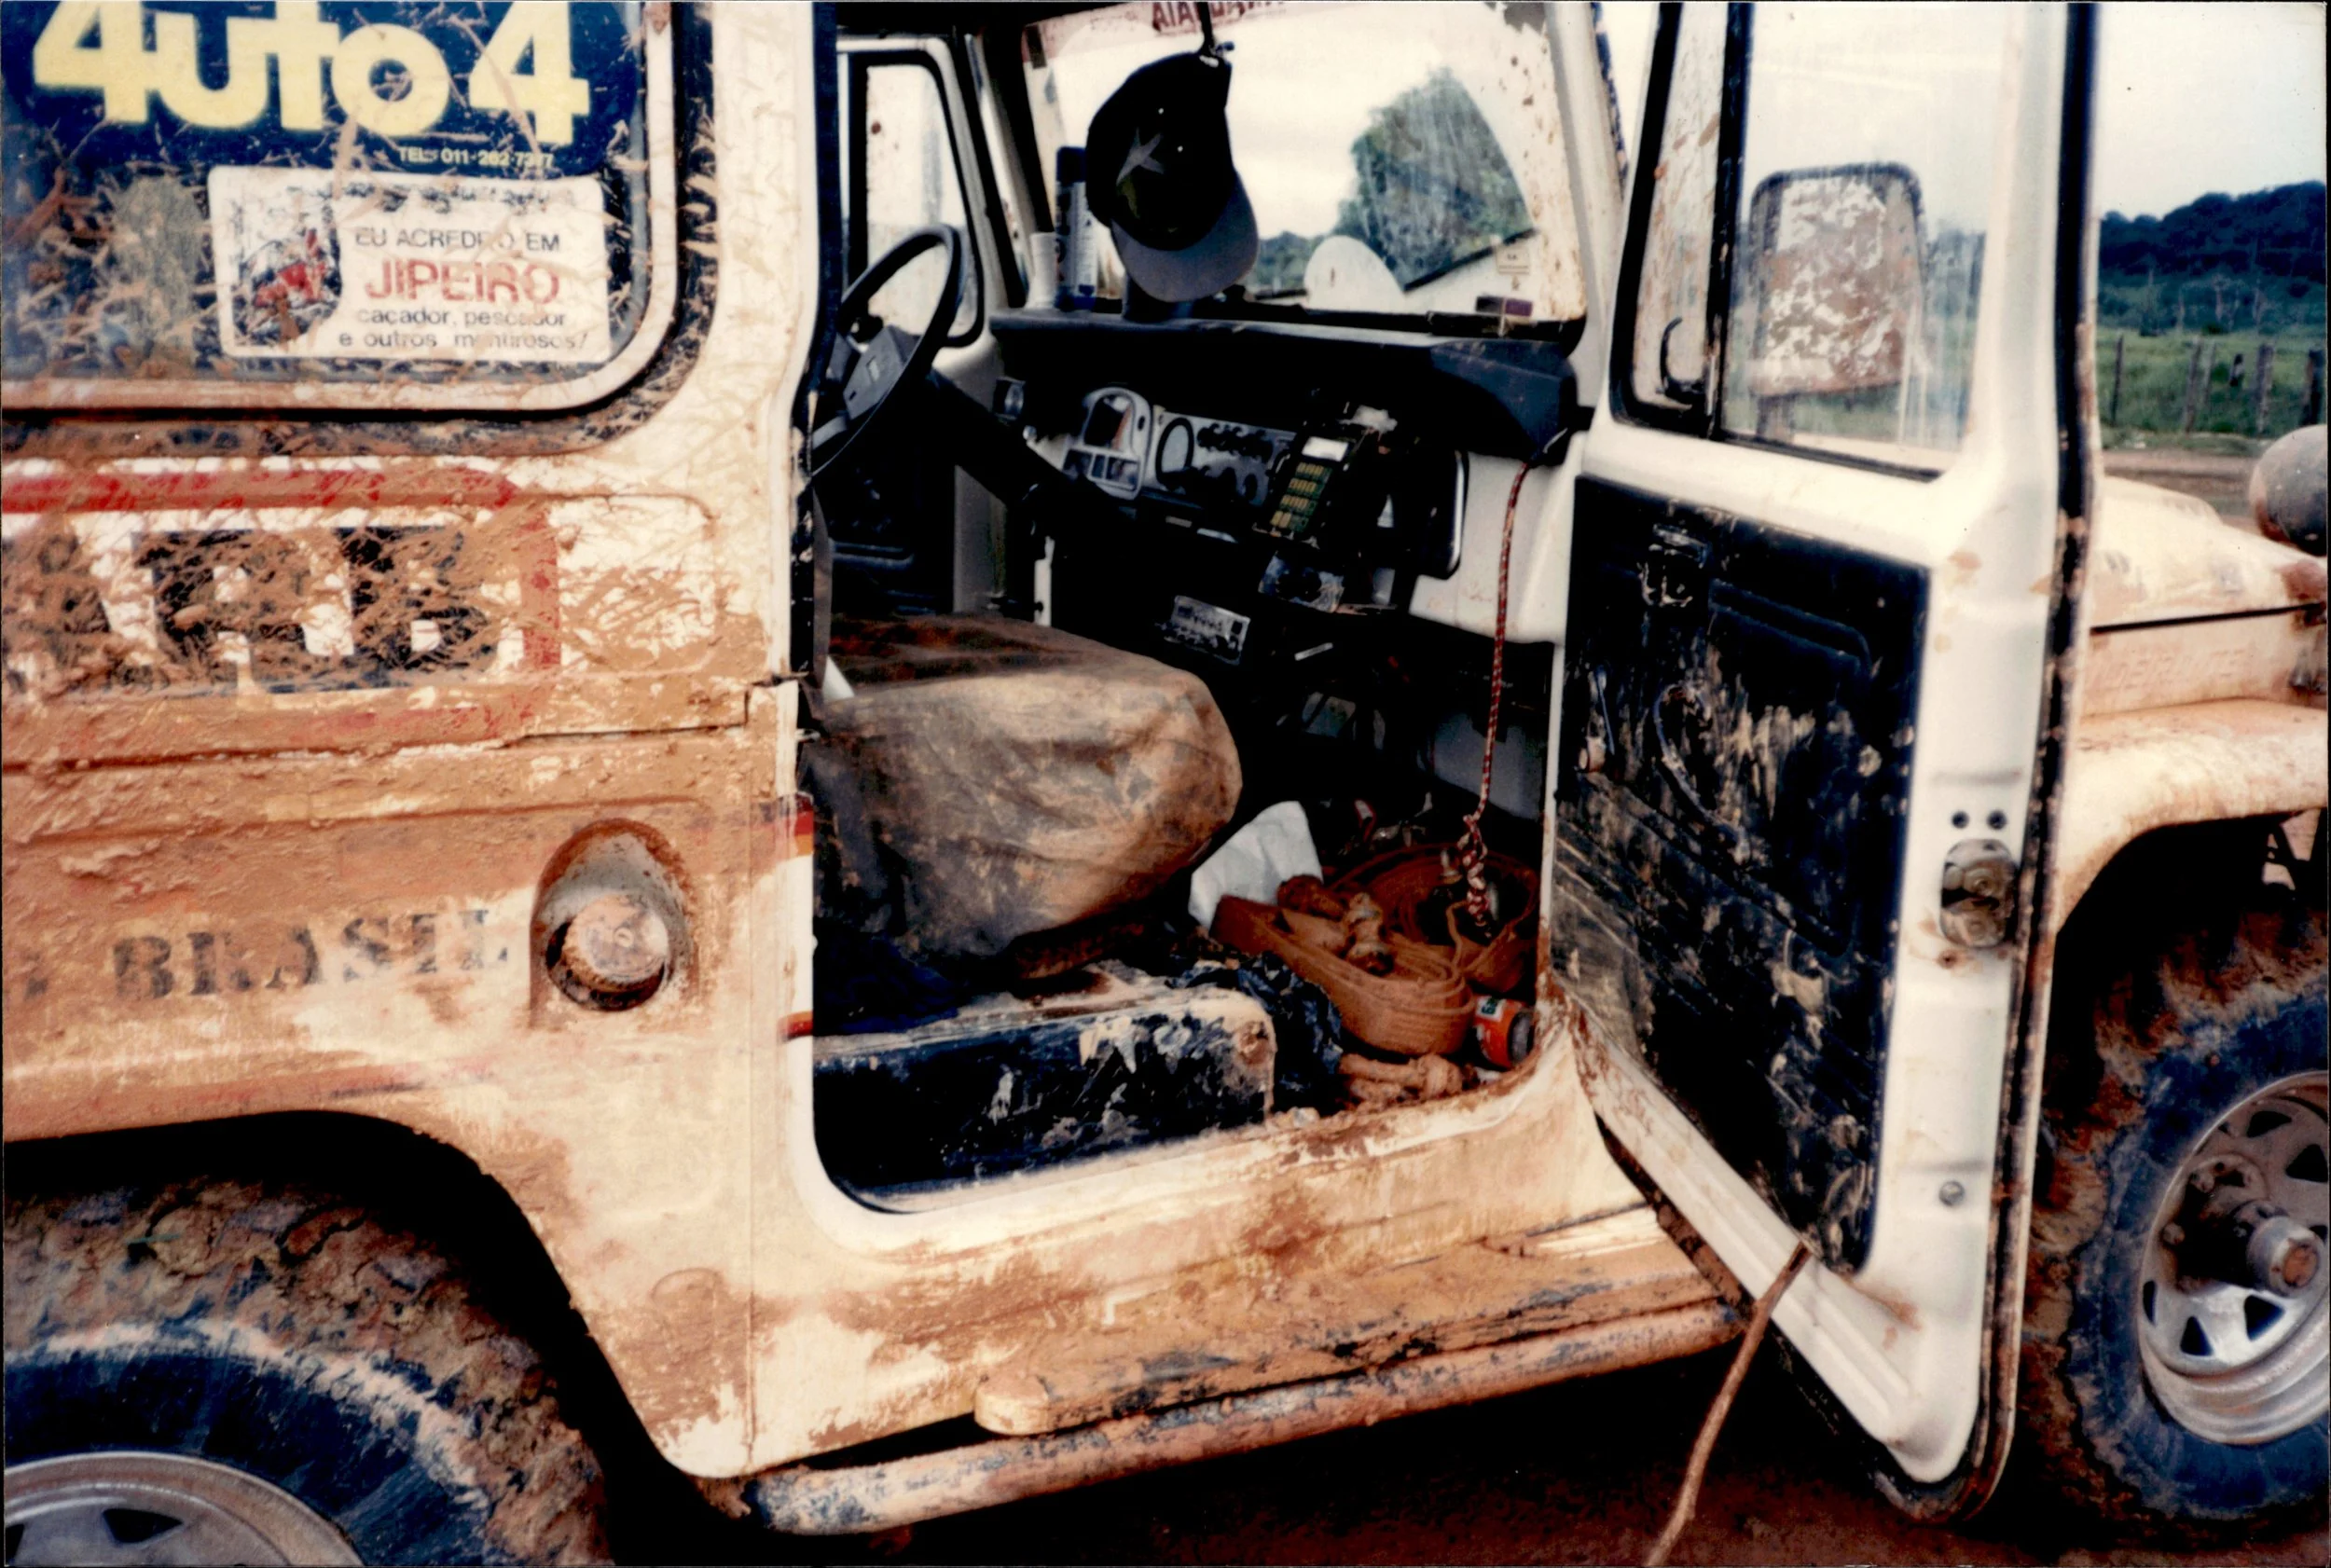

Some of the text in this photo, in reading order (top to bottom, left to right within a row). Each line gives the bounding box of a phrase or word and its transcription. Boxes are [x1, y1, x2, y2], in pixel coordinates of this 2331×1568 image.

[468, 2, 590, 146] 4
[356, 227, 560, 251] EU ACREDIO EM
[365, 258, 559, 304] JIPEIRO
[338, 333, 352, 347] e
[364, 330, 437, 348] outros
